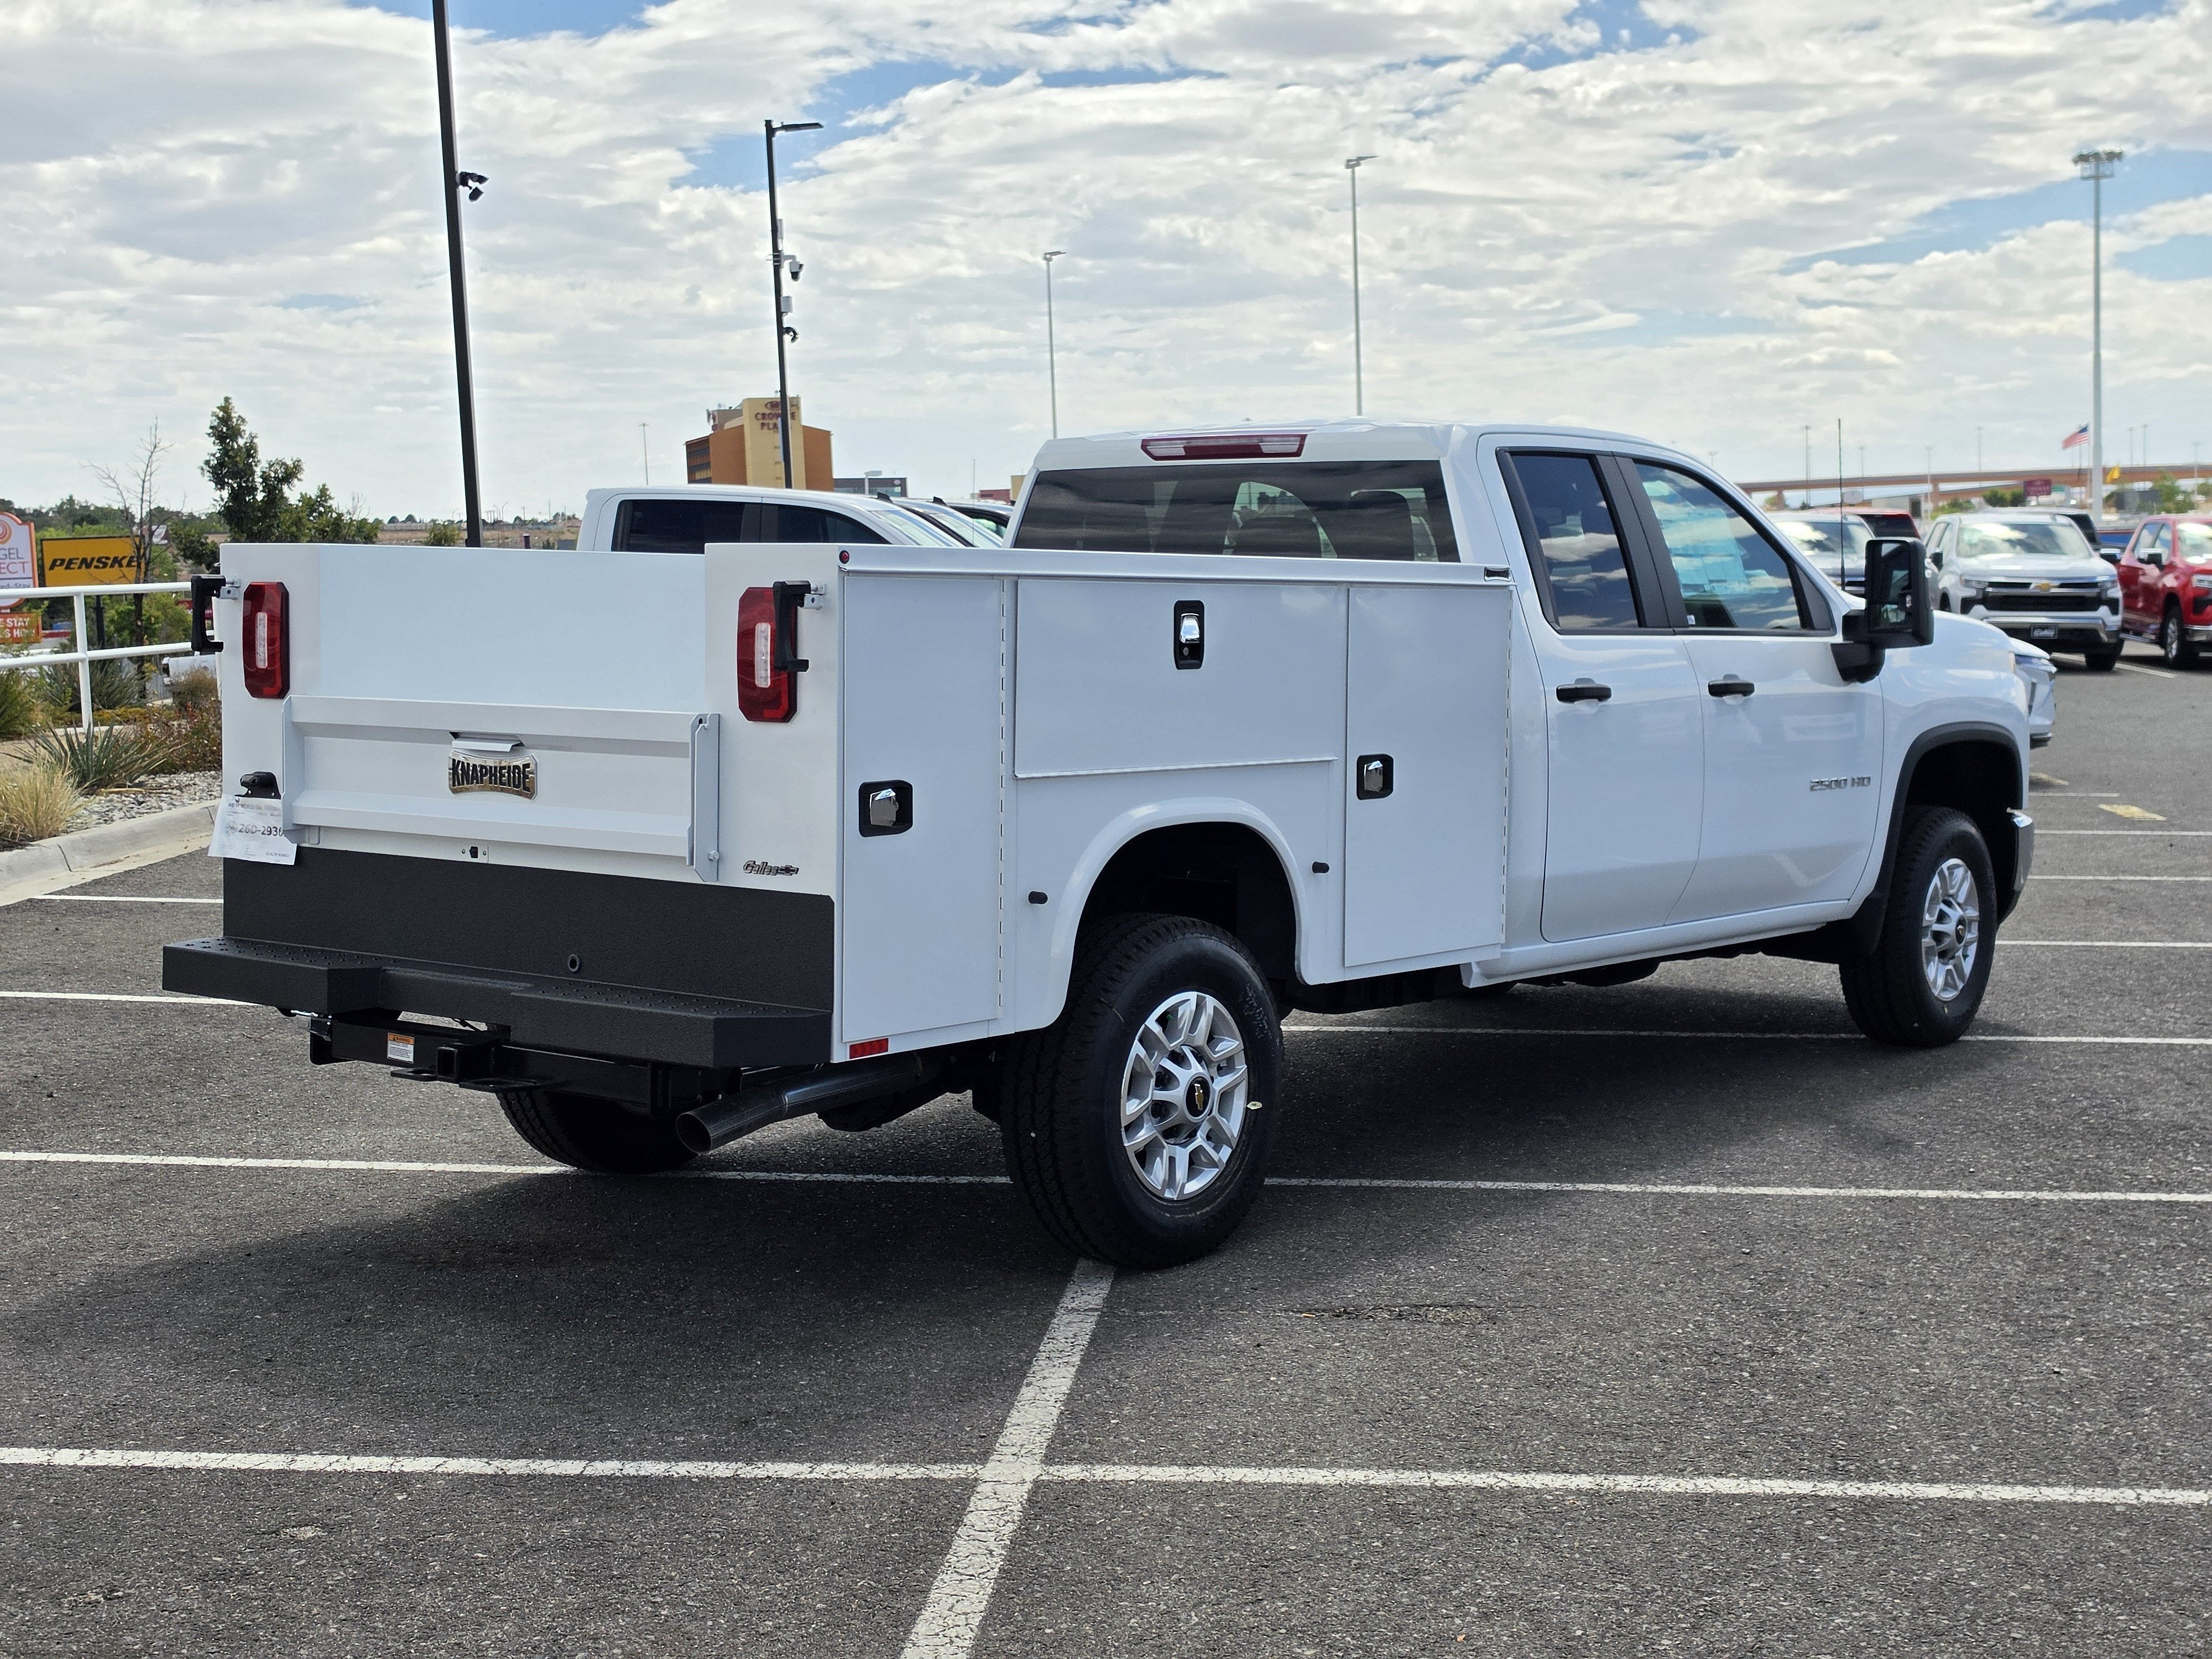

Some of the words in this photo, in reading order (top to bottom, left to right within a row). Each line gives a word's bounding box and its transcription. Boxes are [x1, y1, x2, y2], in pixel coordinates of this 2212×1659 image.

[755, 412, 796, 421] CROWE
[49, 555, 138, 571] PENSKE
[452, 758, 531, 792] KNAPHEIDE
[1809, 777, 1847, 791] 2500
[1850, 776, 1871, 787] HD
